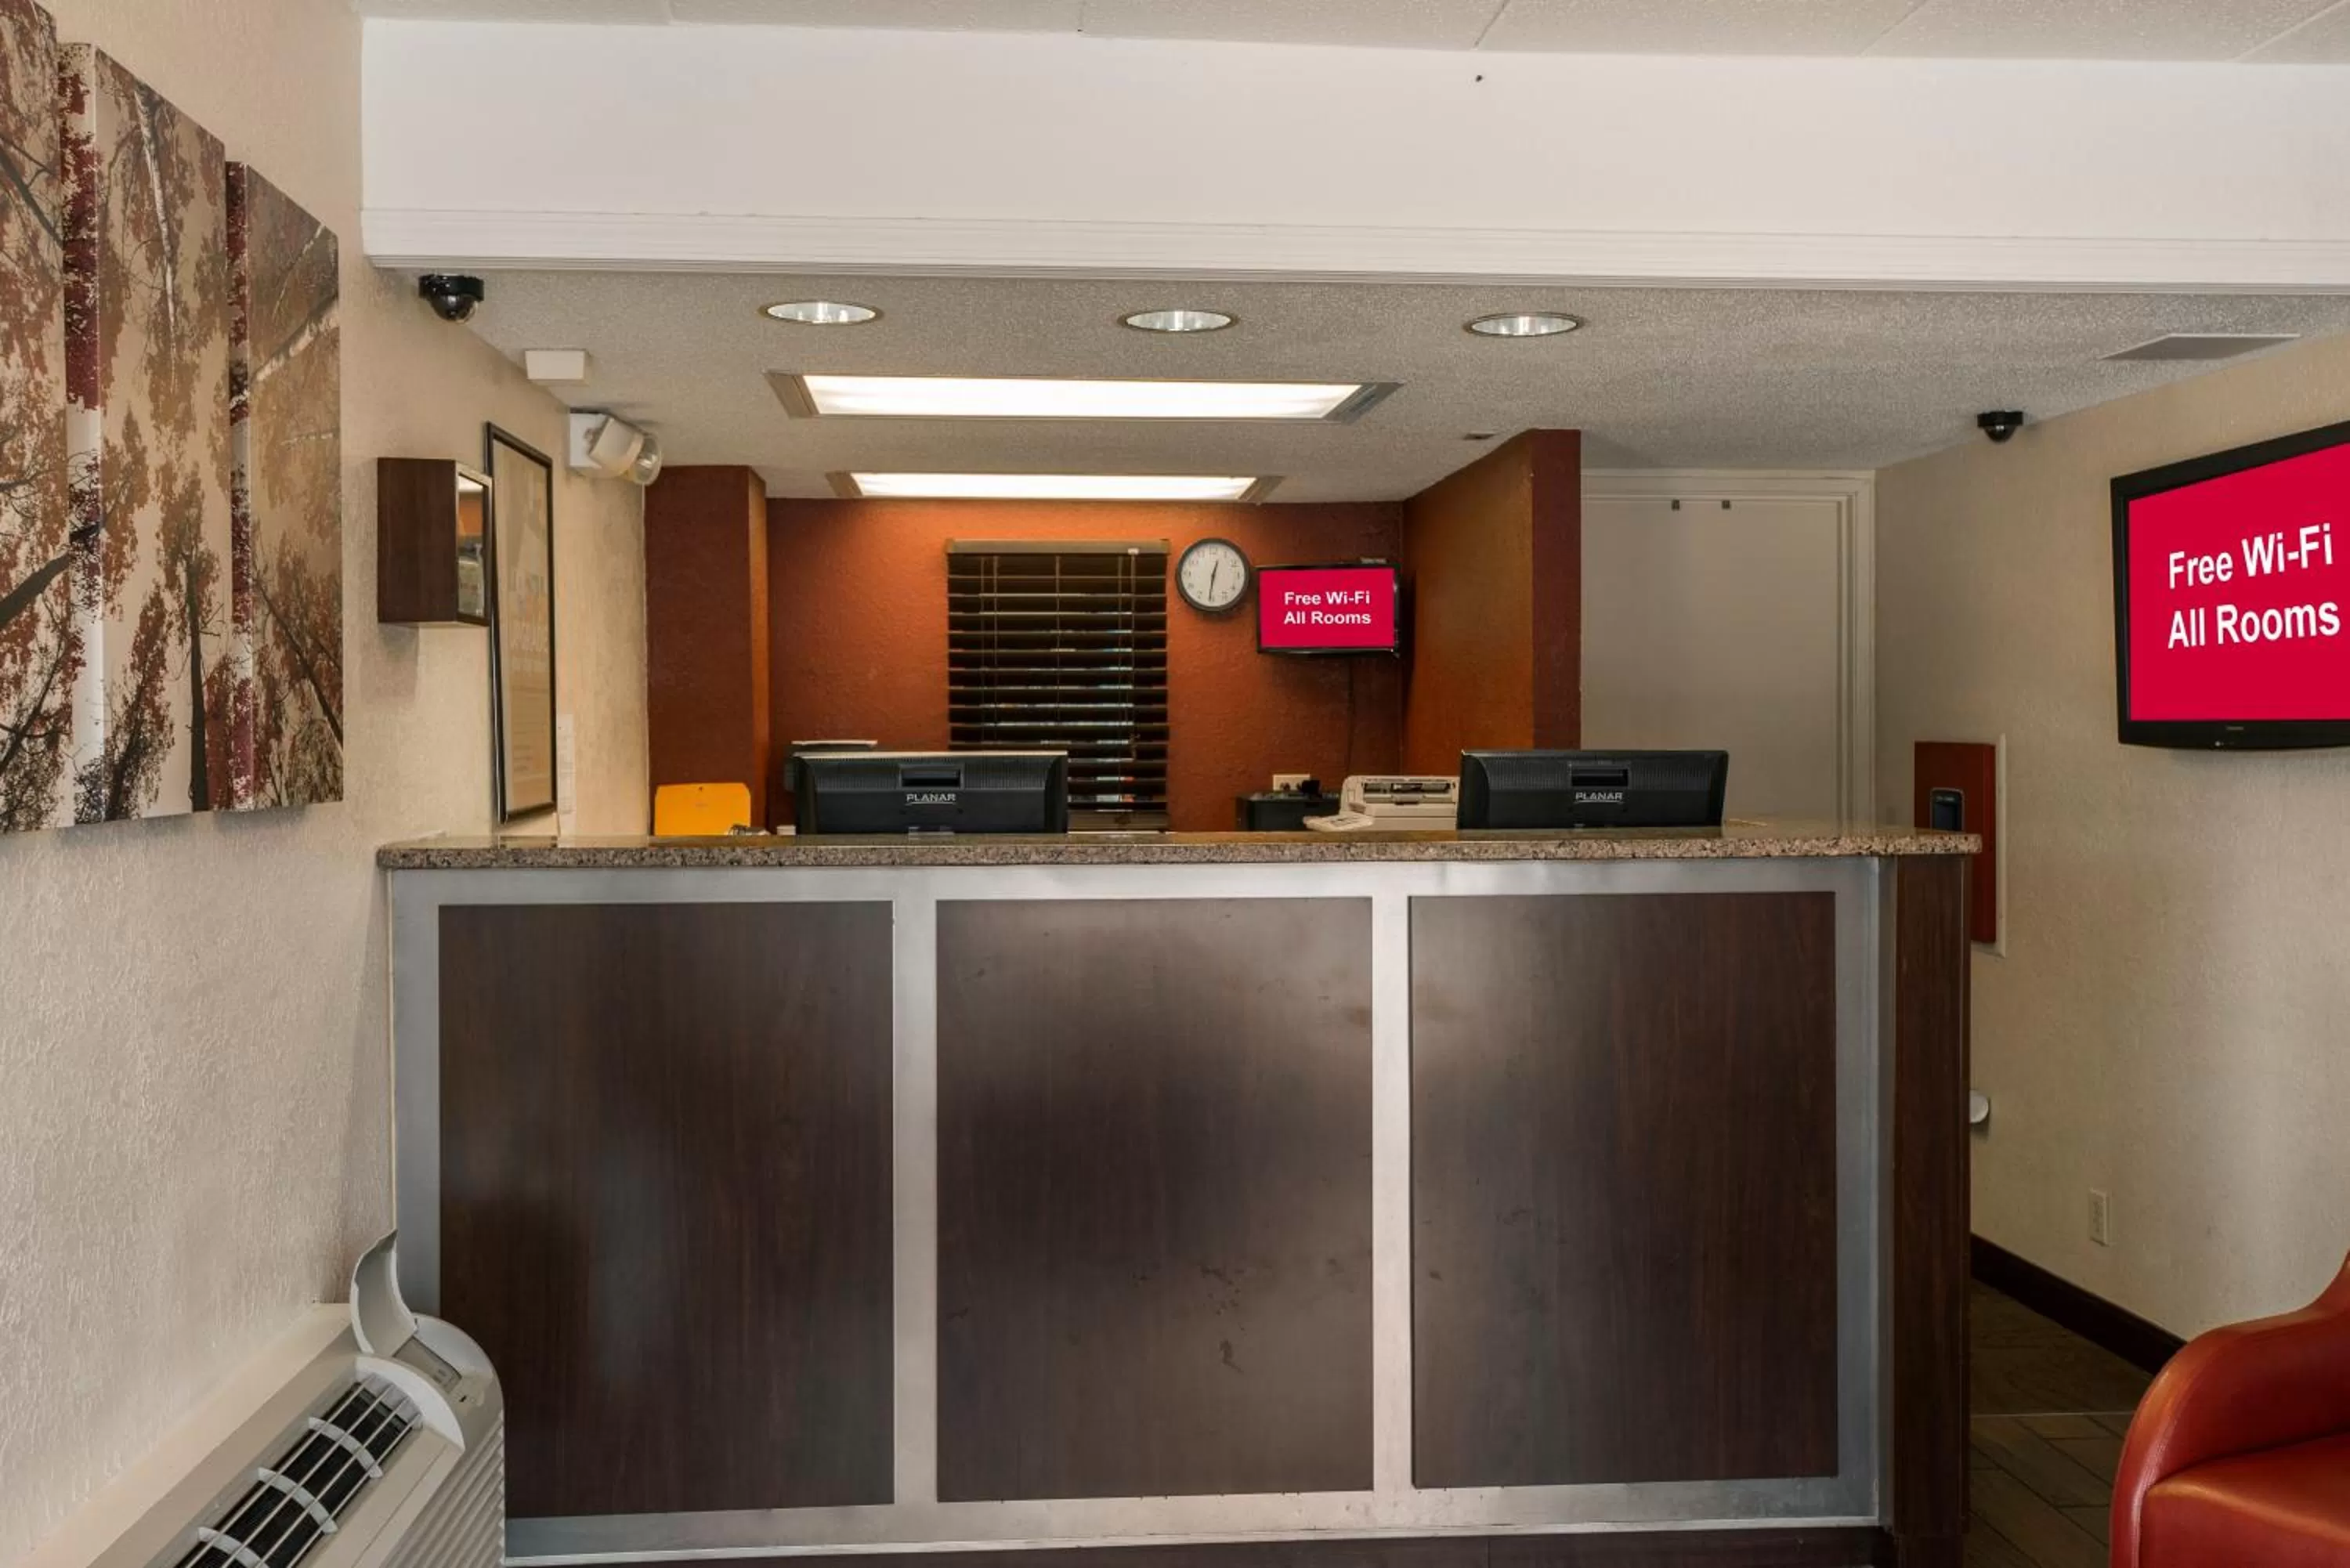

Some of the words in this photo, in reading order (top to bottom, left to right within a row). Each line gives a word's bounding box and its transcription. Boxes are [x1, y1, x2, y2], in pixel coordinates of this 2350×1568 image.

[2168, 550, 2233, 589] Free
[2241, 522, 2334, 577] Wi-Fi
[1284, 591, 1321, 605] Free
[1325, 590, 1371, 605] Wi-Fi
[1283, 611, 1306, 625] All
[1311, 611, 1372, 625] Rooms
[2167, 607, 2206, 649] All
[2216, 602, 2341, 645] Rooms
[906, 793, 956, 803] PLANAR
[1574, 792, 1624, 800] PLANAR
